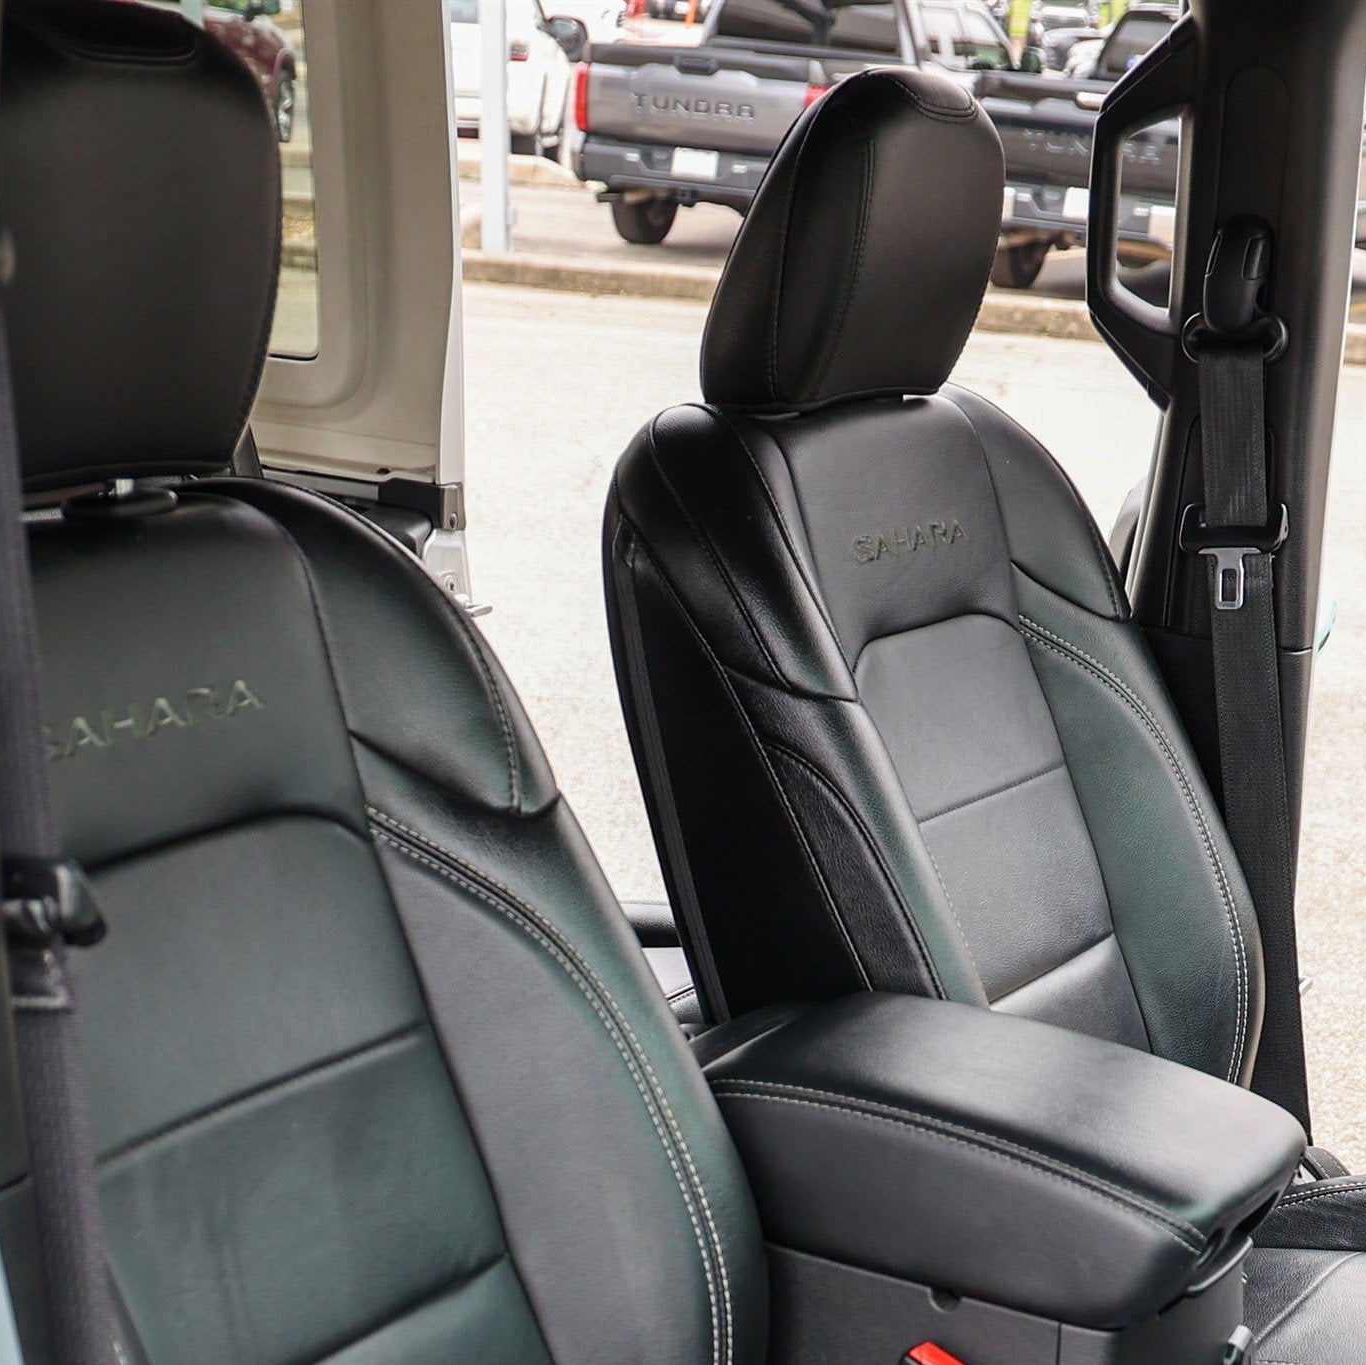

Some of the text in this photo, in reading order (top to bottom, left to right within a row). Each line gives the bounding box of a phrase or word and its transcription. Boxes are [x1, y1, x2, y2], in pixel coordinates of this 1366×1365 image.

[631, 92, 755, 123] TUNDRA
[1023, 129, 1161, 164] TUNRA
[855, 519, 969, 565] SAHARA
